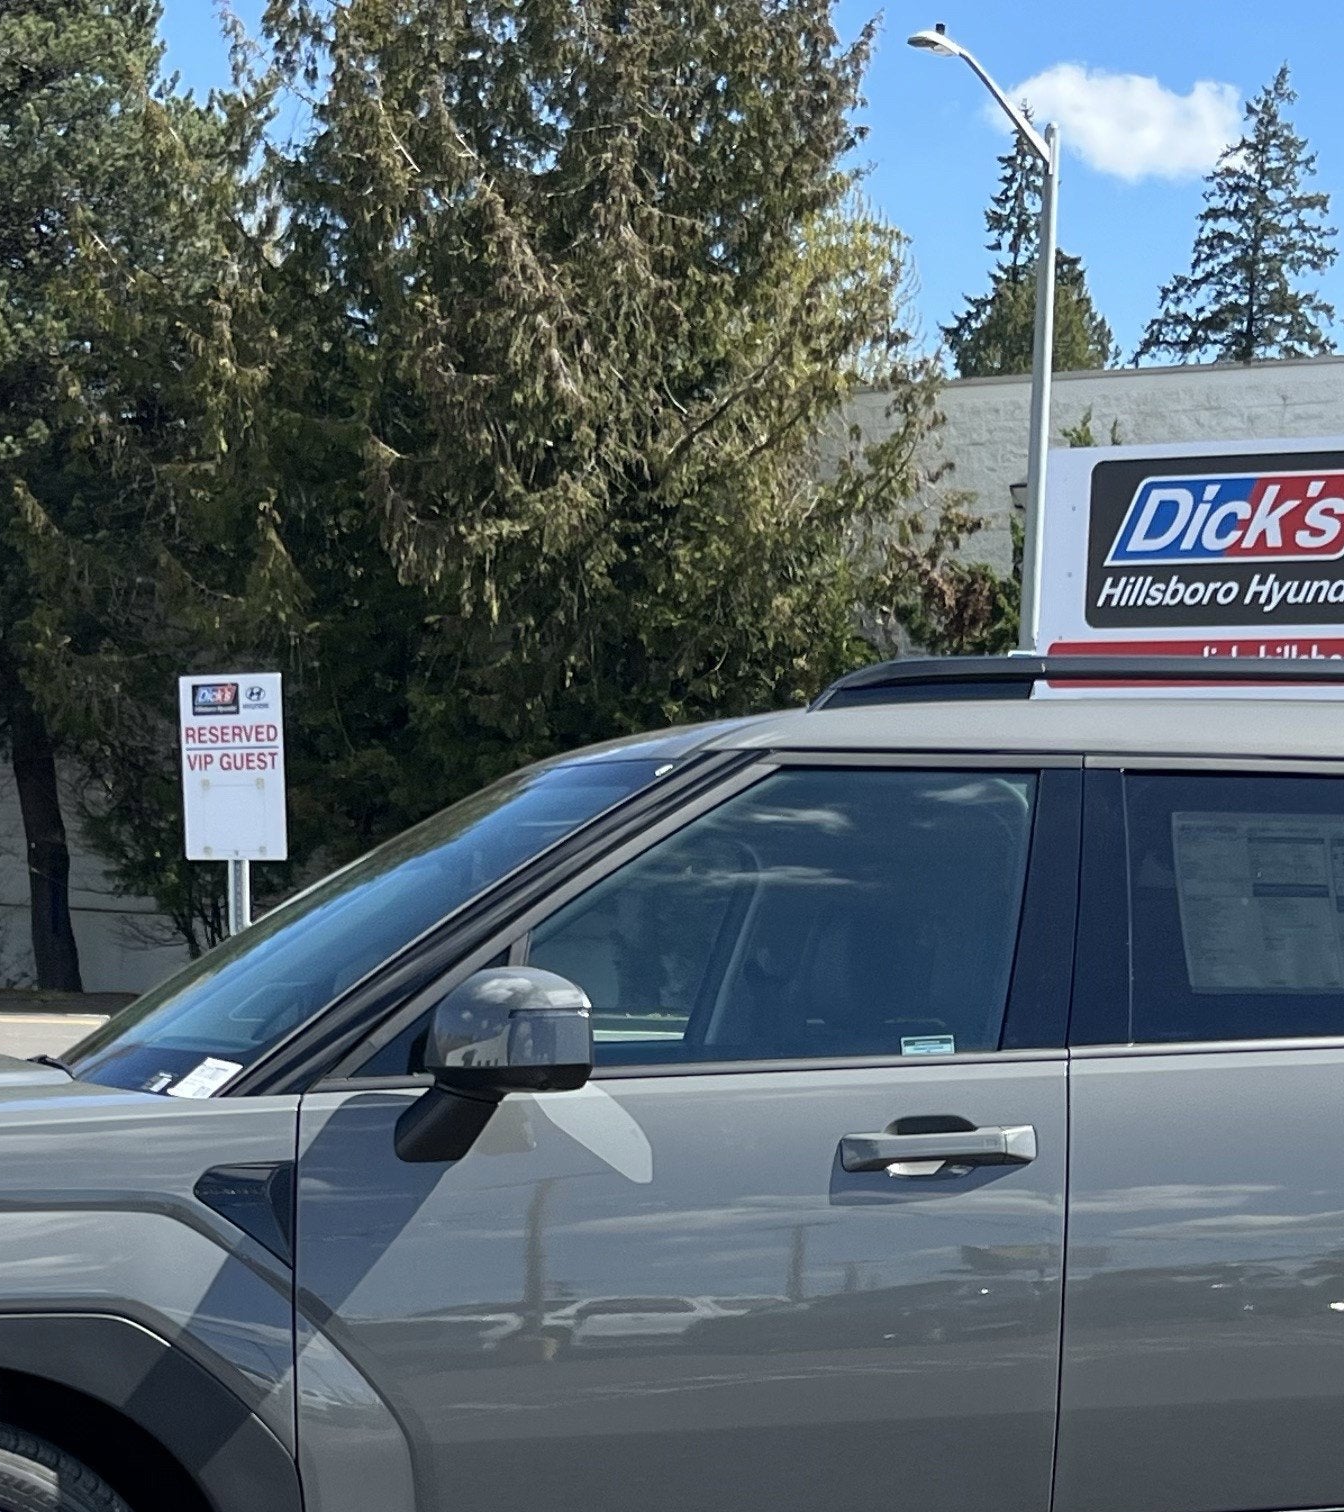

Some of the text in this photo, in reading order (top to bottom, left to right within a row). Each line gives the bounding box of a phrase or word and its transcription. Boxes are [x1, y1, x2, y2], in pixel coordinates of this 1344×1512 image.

[1096, 574, 1240, 608] Hillsboro
[184, 724, 278, 744] RESERVED
[186, 752, 279, 771] VIP GUEST
